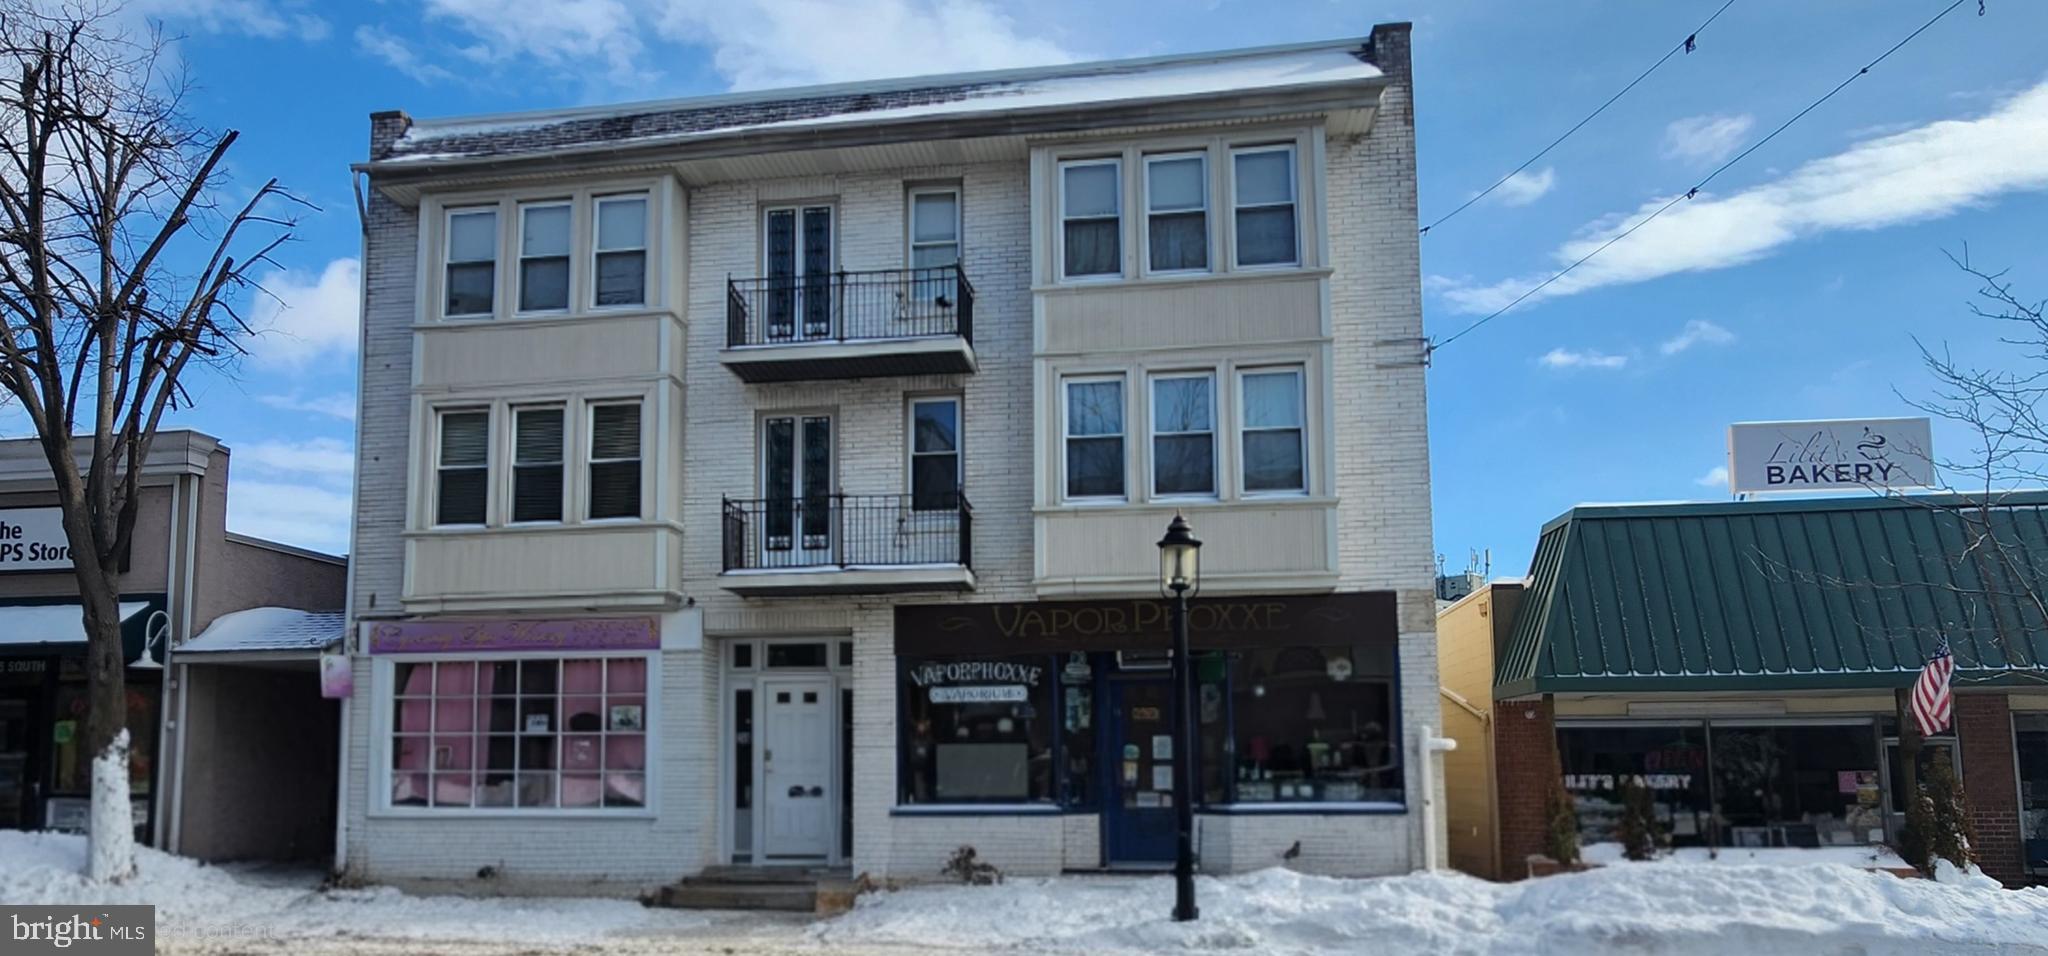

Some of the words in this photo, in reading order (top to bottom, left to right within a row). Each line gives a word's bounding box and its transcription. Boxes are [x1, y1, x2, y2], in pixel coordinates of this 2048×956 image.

[1766, 461, 1895, 485] BAKERY
[7, 659, 47, 673] SOUTH
[909, 661, 1043, 687] VAPORPHOXXE
